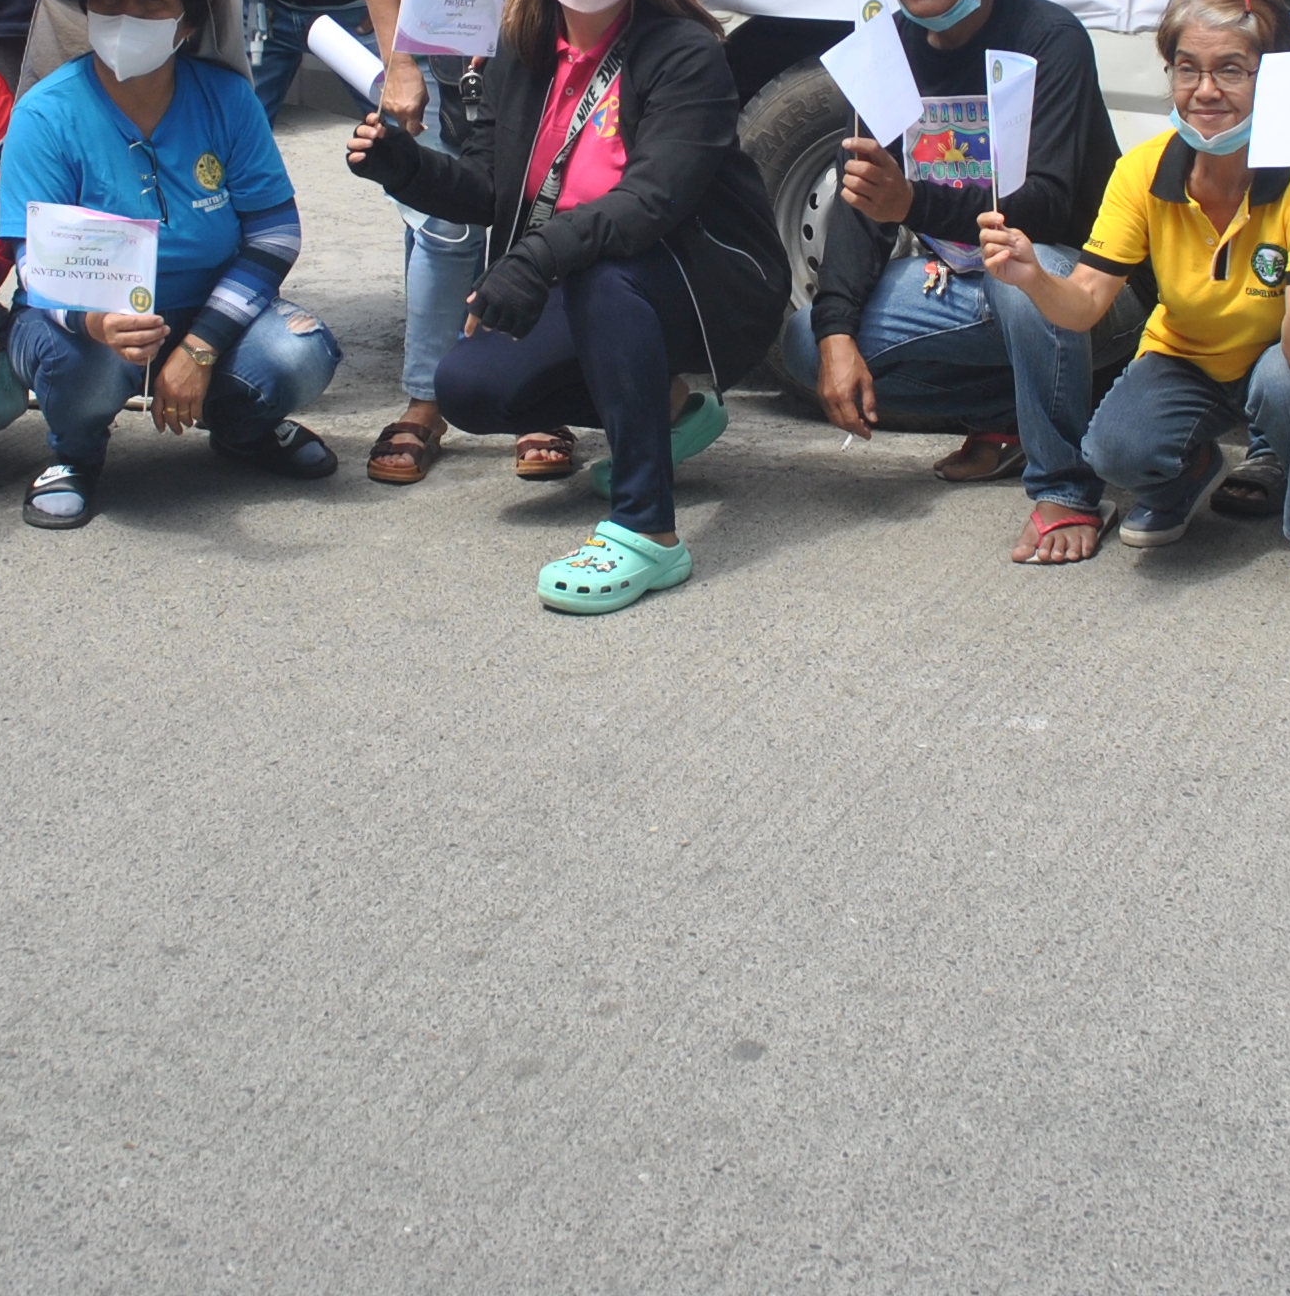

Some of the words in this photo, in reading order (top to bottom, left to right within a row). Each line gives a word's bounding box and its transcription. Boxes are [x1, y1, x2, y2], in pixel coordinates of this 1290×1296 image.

[576, 85, 600, 126] NIKE
[751, 85, 833, 163] MRF
[918, 161, 994, 181] POLICE
[65, 256, 109, 266] PROJECT
[31, 267, 66, 278] CLEAN!
[69, 270, 105, 280] CLEAN!
[107, 272, 143, 283] CLEAN!
